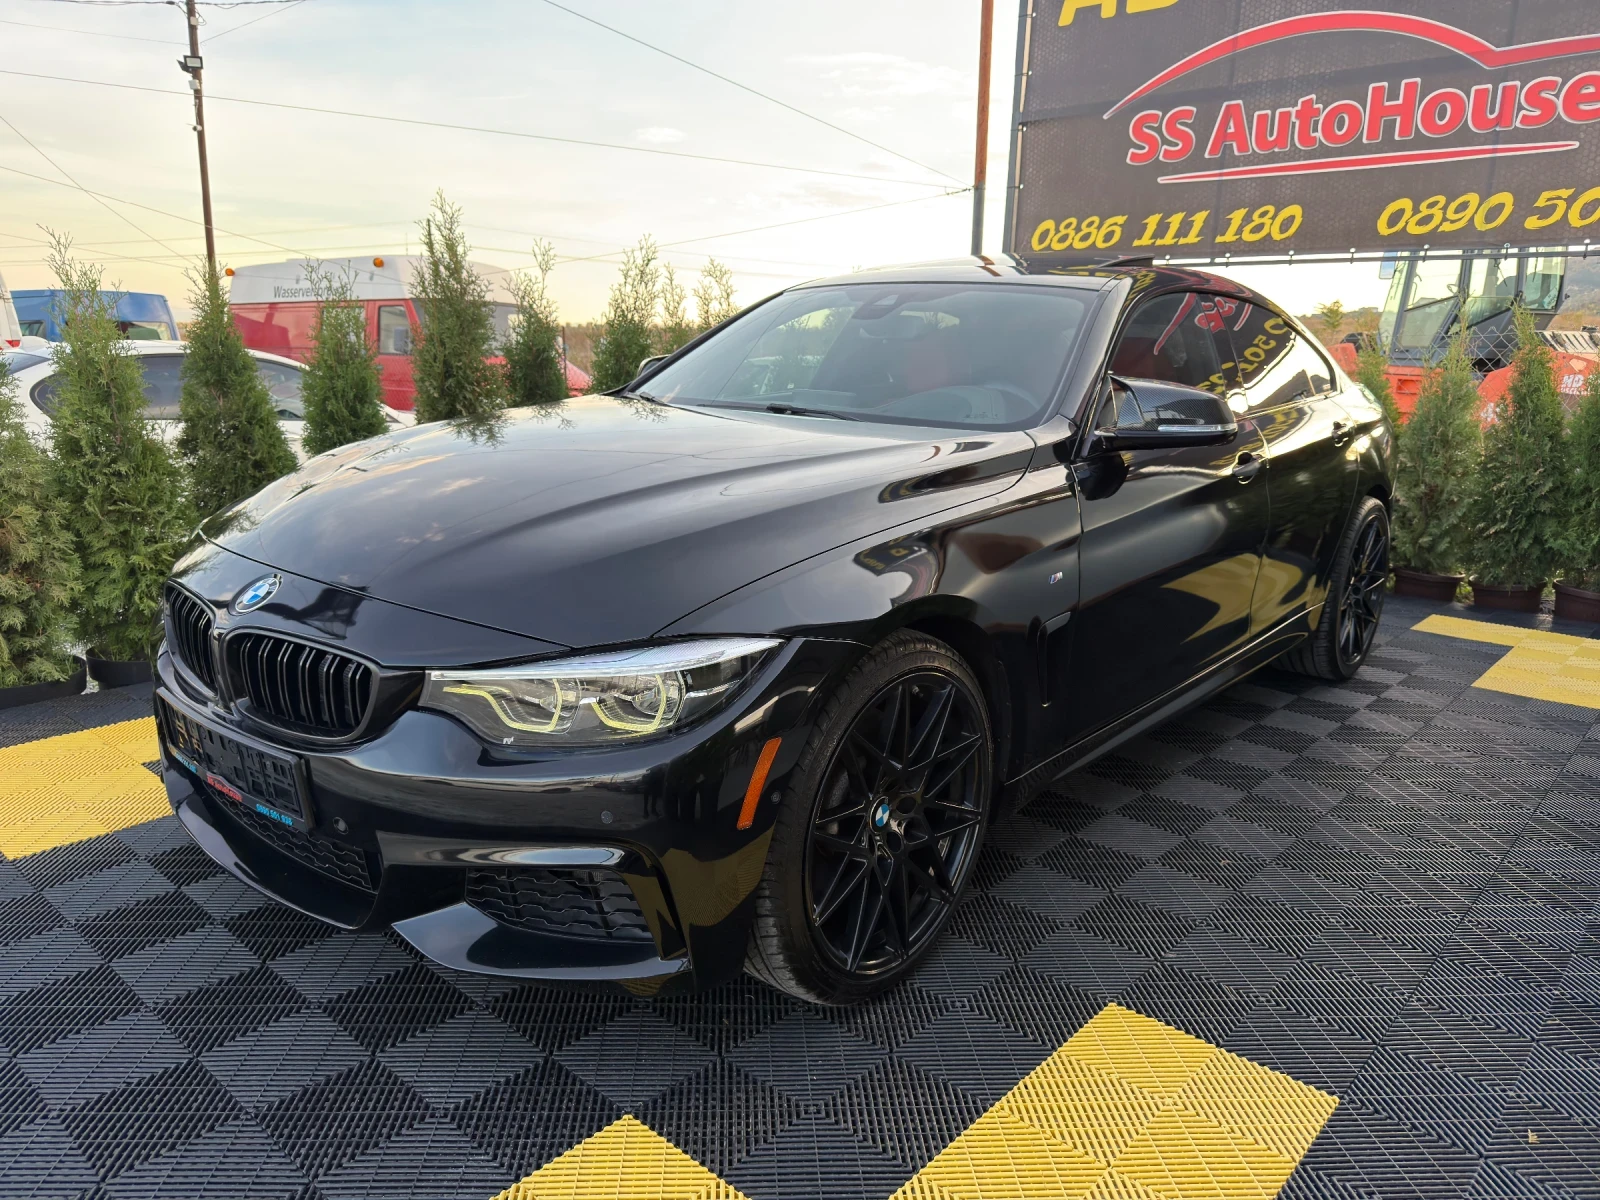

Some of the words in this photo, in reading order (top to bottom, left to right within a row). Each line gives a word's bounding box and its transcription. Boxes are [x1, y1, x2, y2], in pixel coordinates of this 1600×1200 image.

[1126, 106, 1196, 164] SS
[1204, 70, 1600, 159] AutoHouse
[1031, 215, 1128, 251] 0886
[1132, 209, 1210, 247] 111
[1215, 204, 1303, 243] 180
[1377, 191, 1514, 236] 0890
